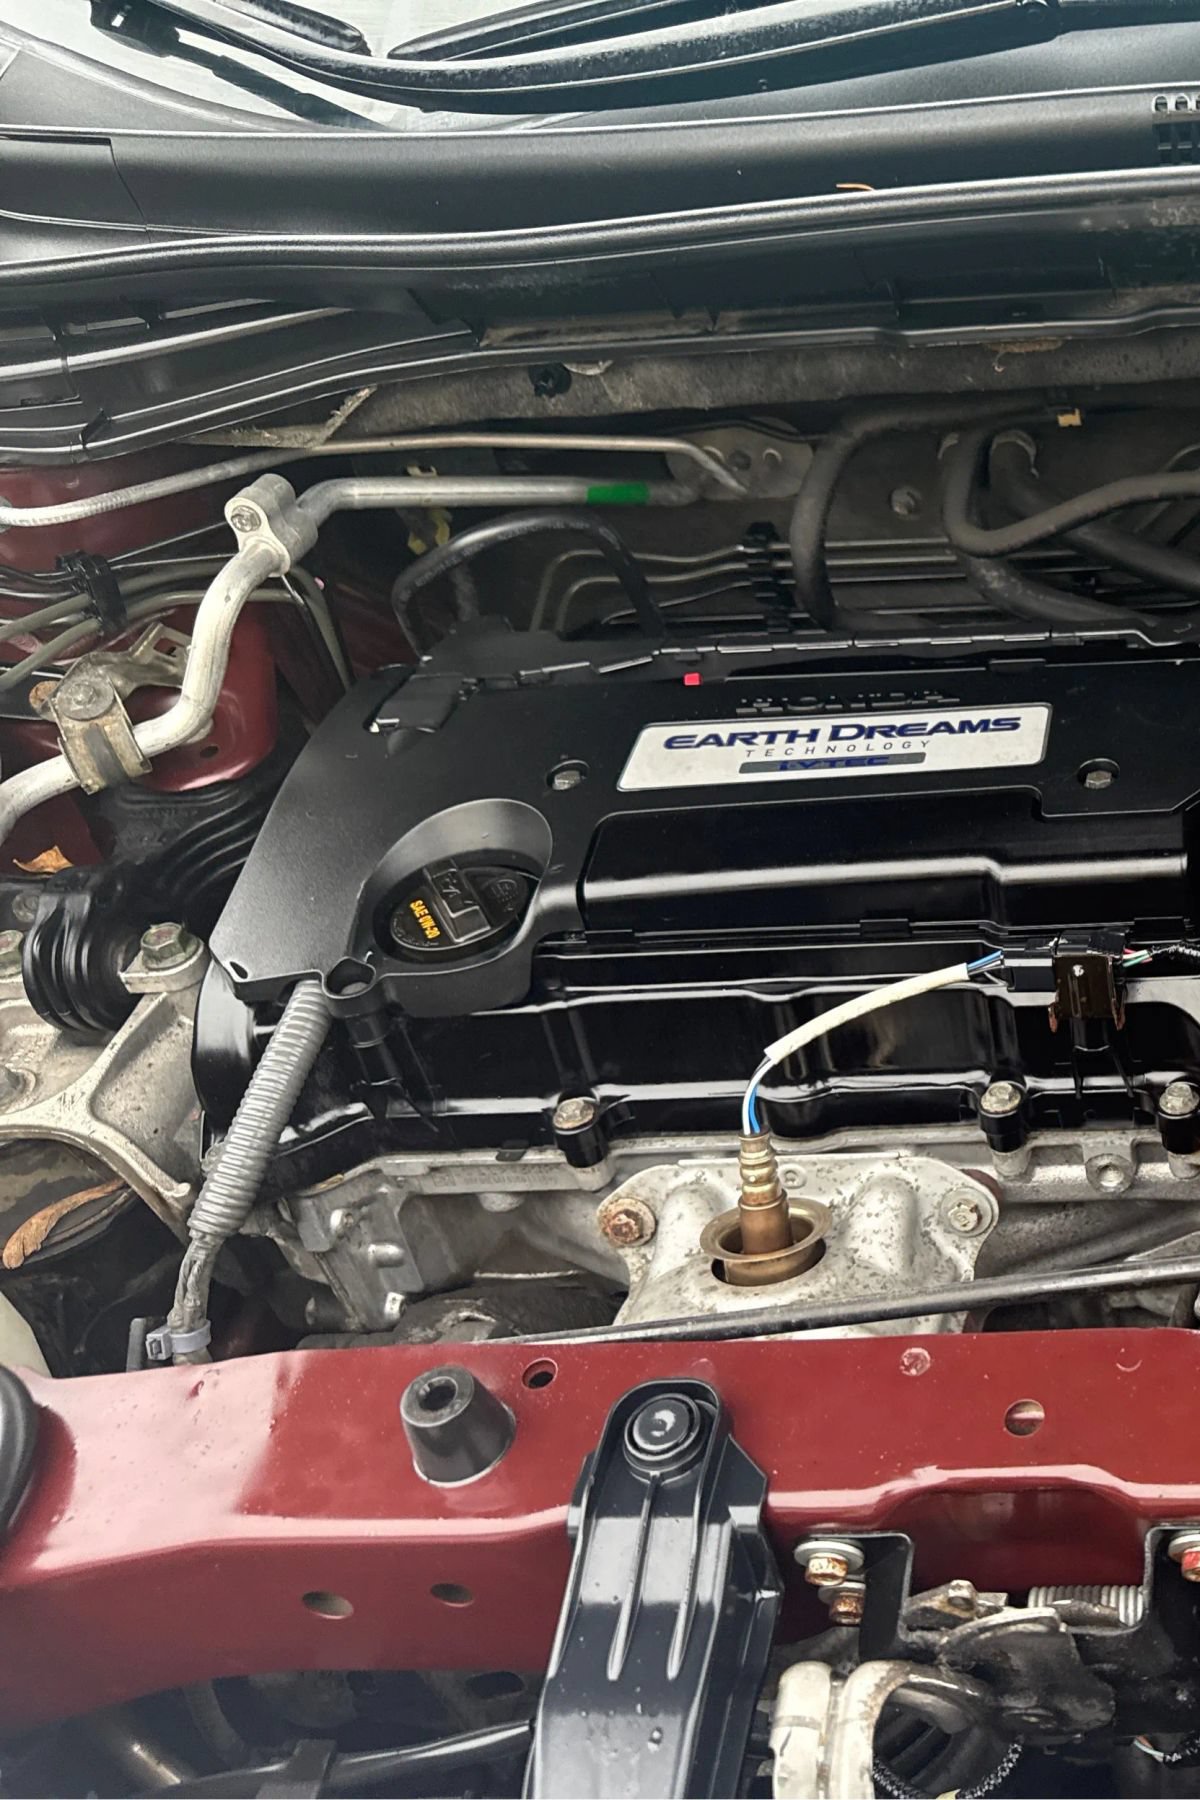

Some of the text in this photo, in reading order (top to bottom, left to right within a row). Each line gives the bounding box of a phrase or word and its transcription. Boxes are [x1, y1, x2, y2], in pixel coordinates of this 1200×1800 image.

[664, 717, 1022, 750] EARTH DREAMS
[746, 740, 930, 758] TECHNOLOGY
[410, 899, 429, 918] SAE
